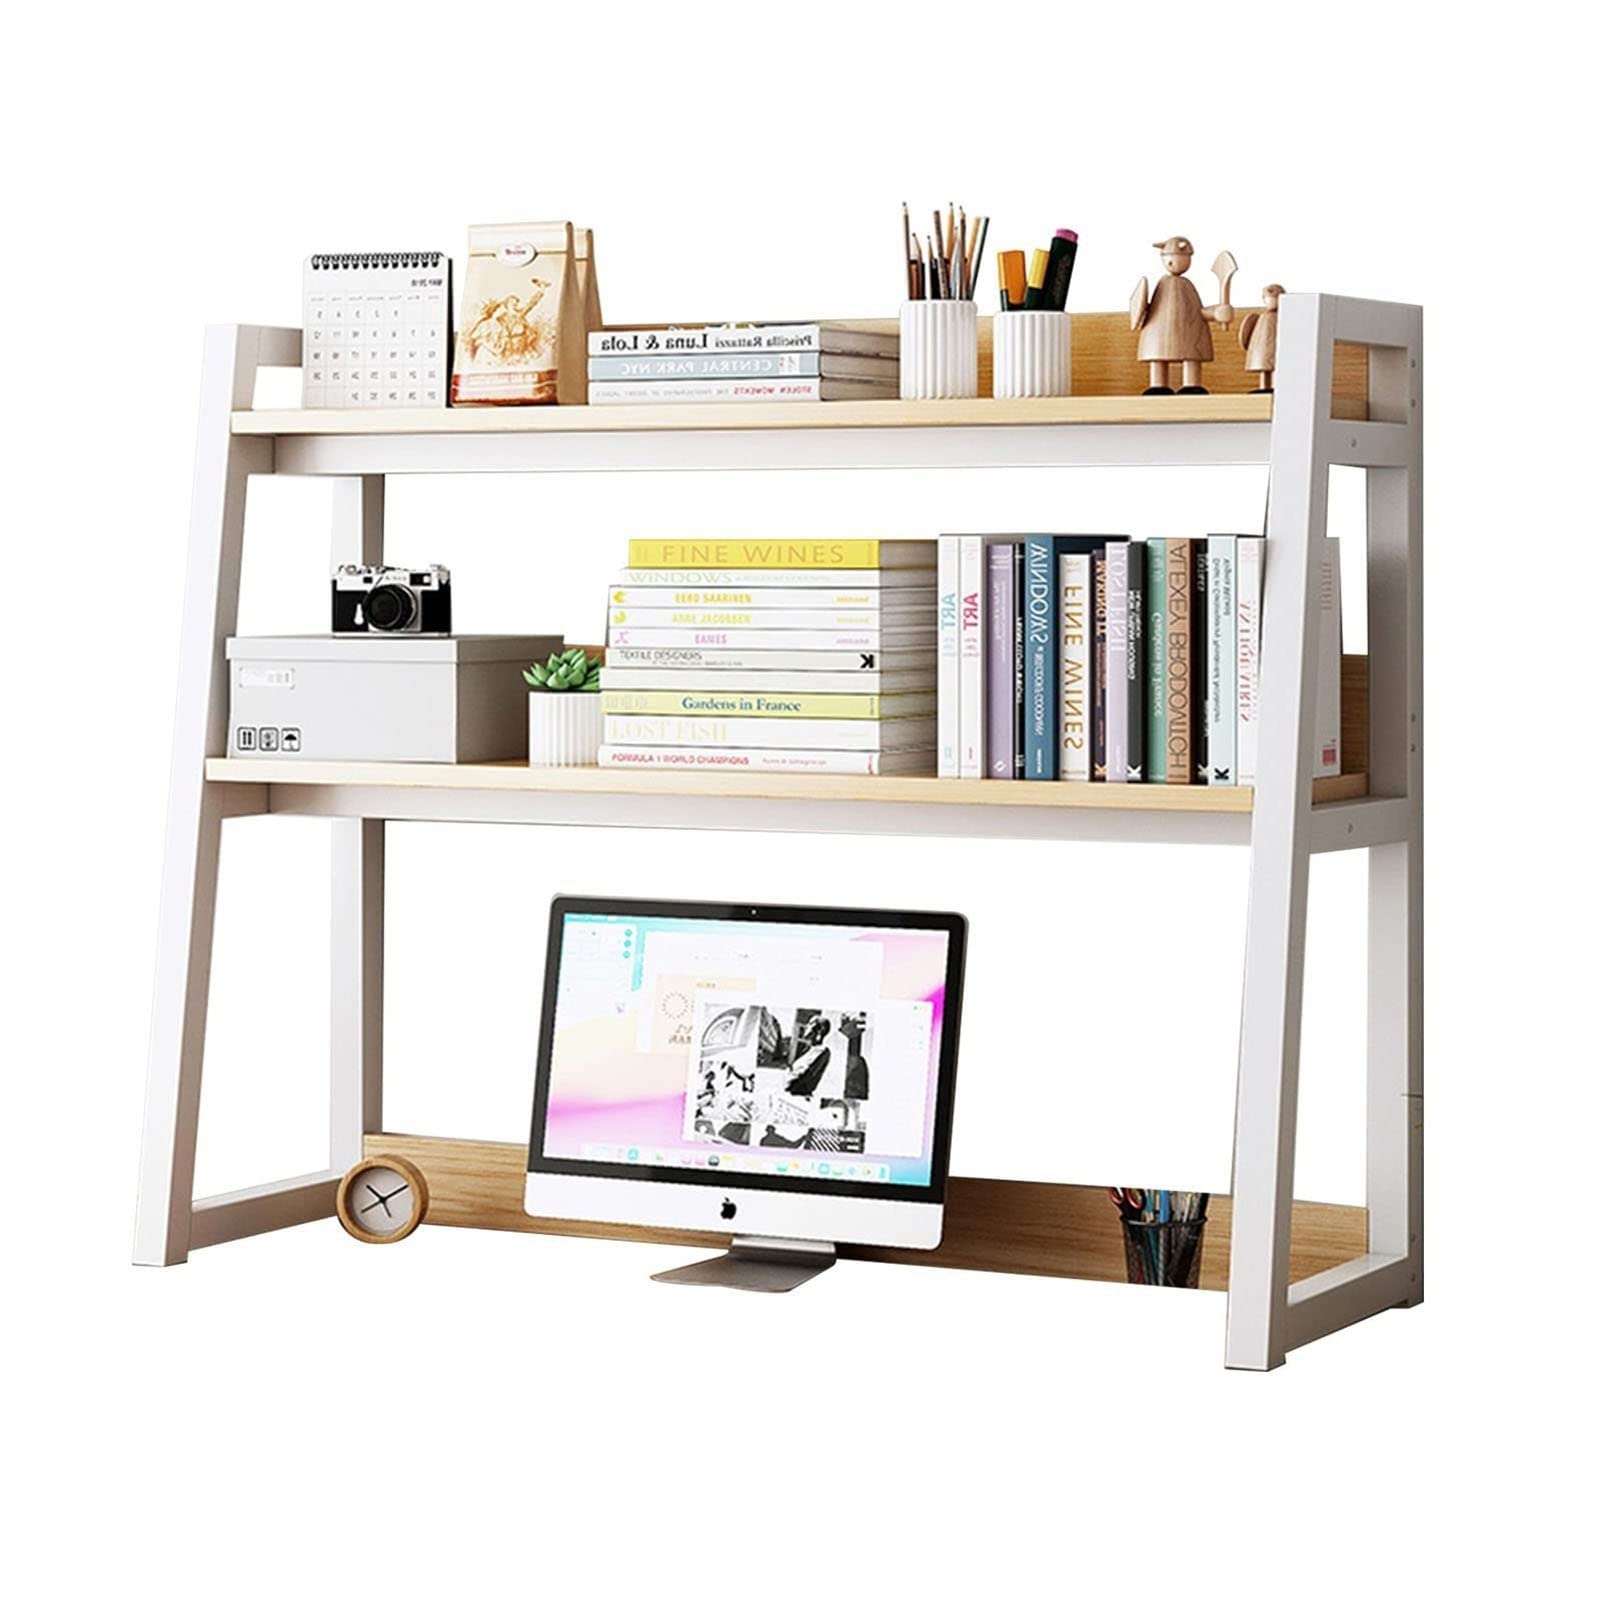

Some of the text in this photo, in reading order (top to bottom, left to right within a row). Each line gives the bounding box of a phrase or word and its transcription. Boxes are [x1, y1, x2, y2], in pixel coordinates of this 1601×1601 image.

[662, 545, 845, 564] FINE WINES
[628, 572, 733, 584] WINDOWS
[682, 697, 802, 712] Gardens in France
[610, 720, 728, 742] LOST FISH
